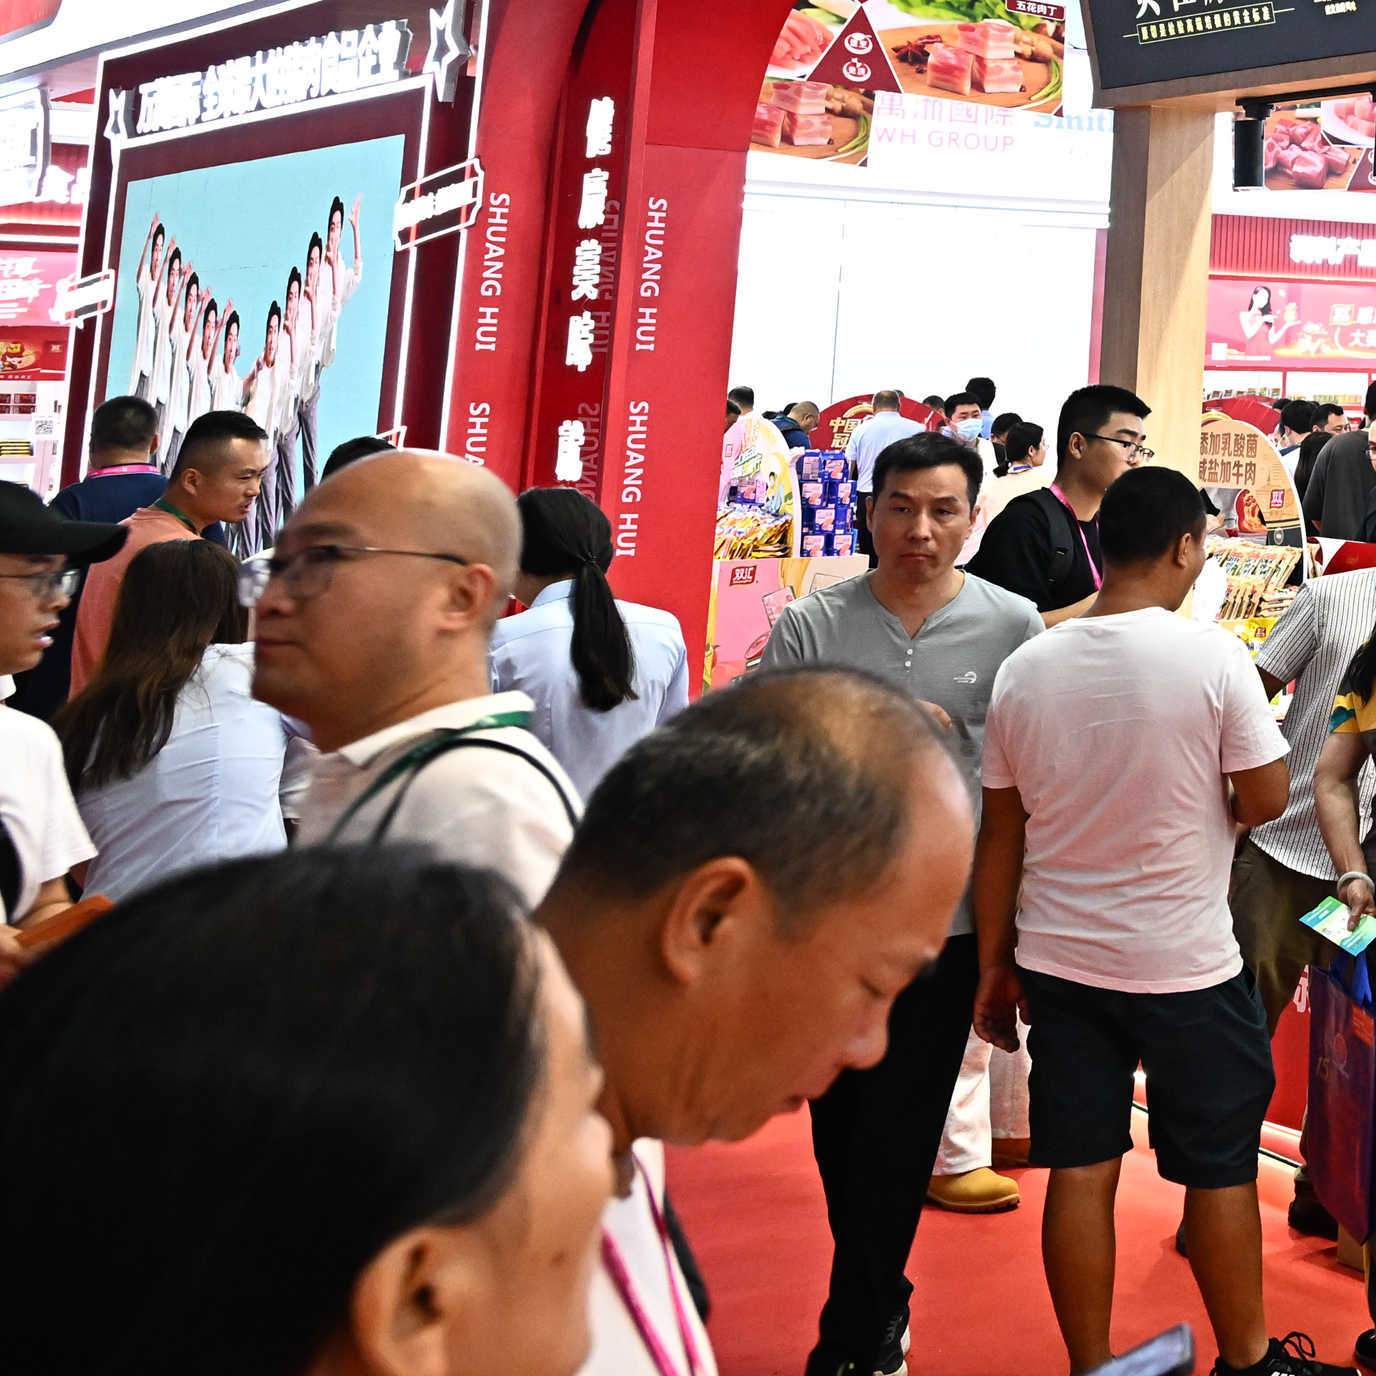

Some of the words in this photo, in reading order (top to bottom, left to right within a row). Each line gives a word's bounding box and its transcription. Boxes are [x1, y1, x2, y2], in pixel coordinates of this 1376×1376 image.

[876, 127, 917, 145] WH
[927, 128, 1015, 154] GROUP
[479, 192, 511, 297] SHUANG
[634, 197, 668, 298] SHUANG
[474, 307, 499, 352] HUI
[635, 307, 658, 352] HUI
[620, 400, 650, 504] SHUANG
[614, 512, 640, 558] HUI
